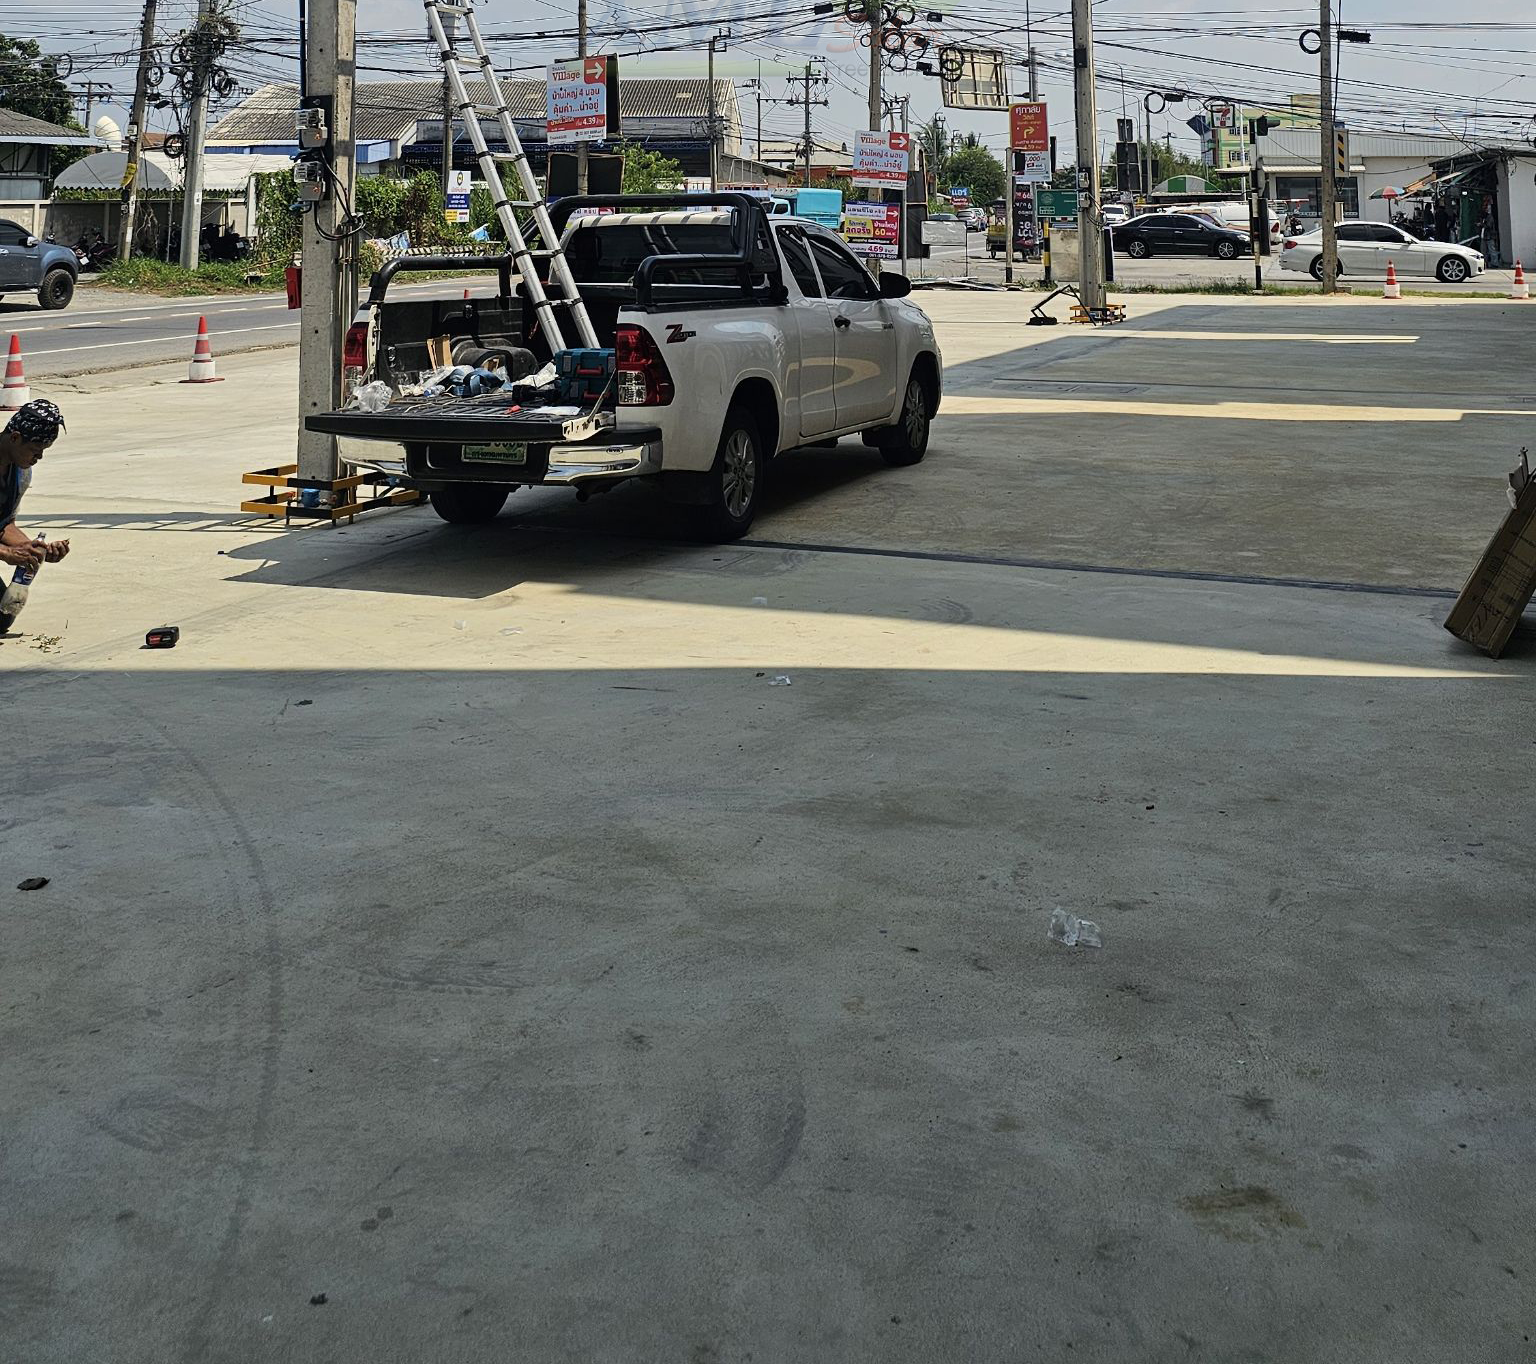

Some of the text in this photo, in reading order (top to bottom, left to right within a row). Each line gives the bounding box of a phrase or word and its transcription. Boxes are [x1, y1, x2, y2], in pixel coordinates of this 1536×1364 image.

[552, 70, 581, 82] Village
[582, 116, 596, 125] 4.39
[860, 136, 887, 146] Village
[874, 228, 886, 236] 60
